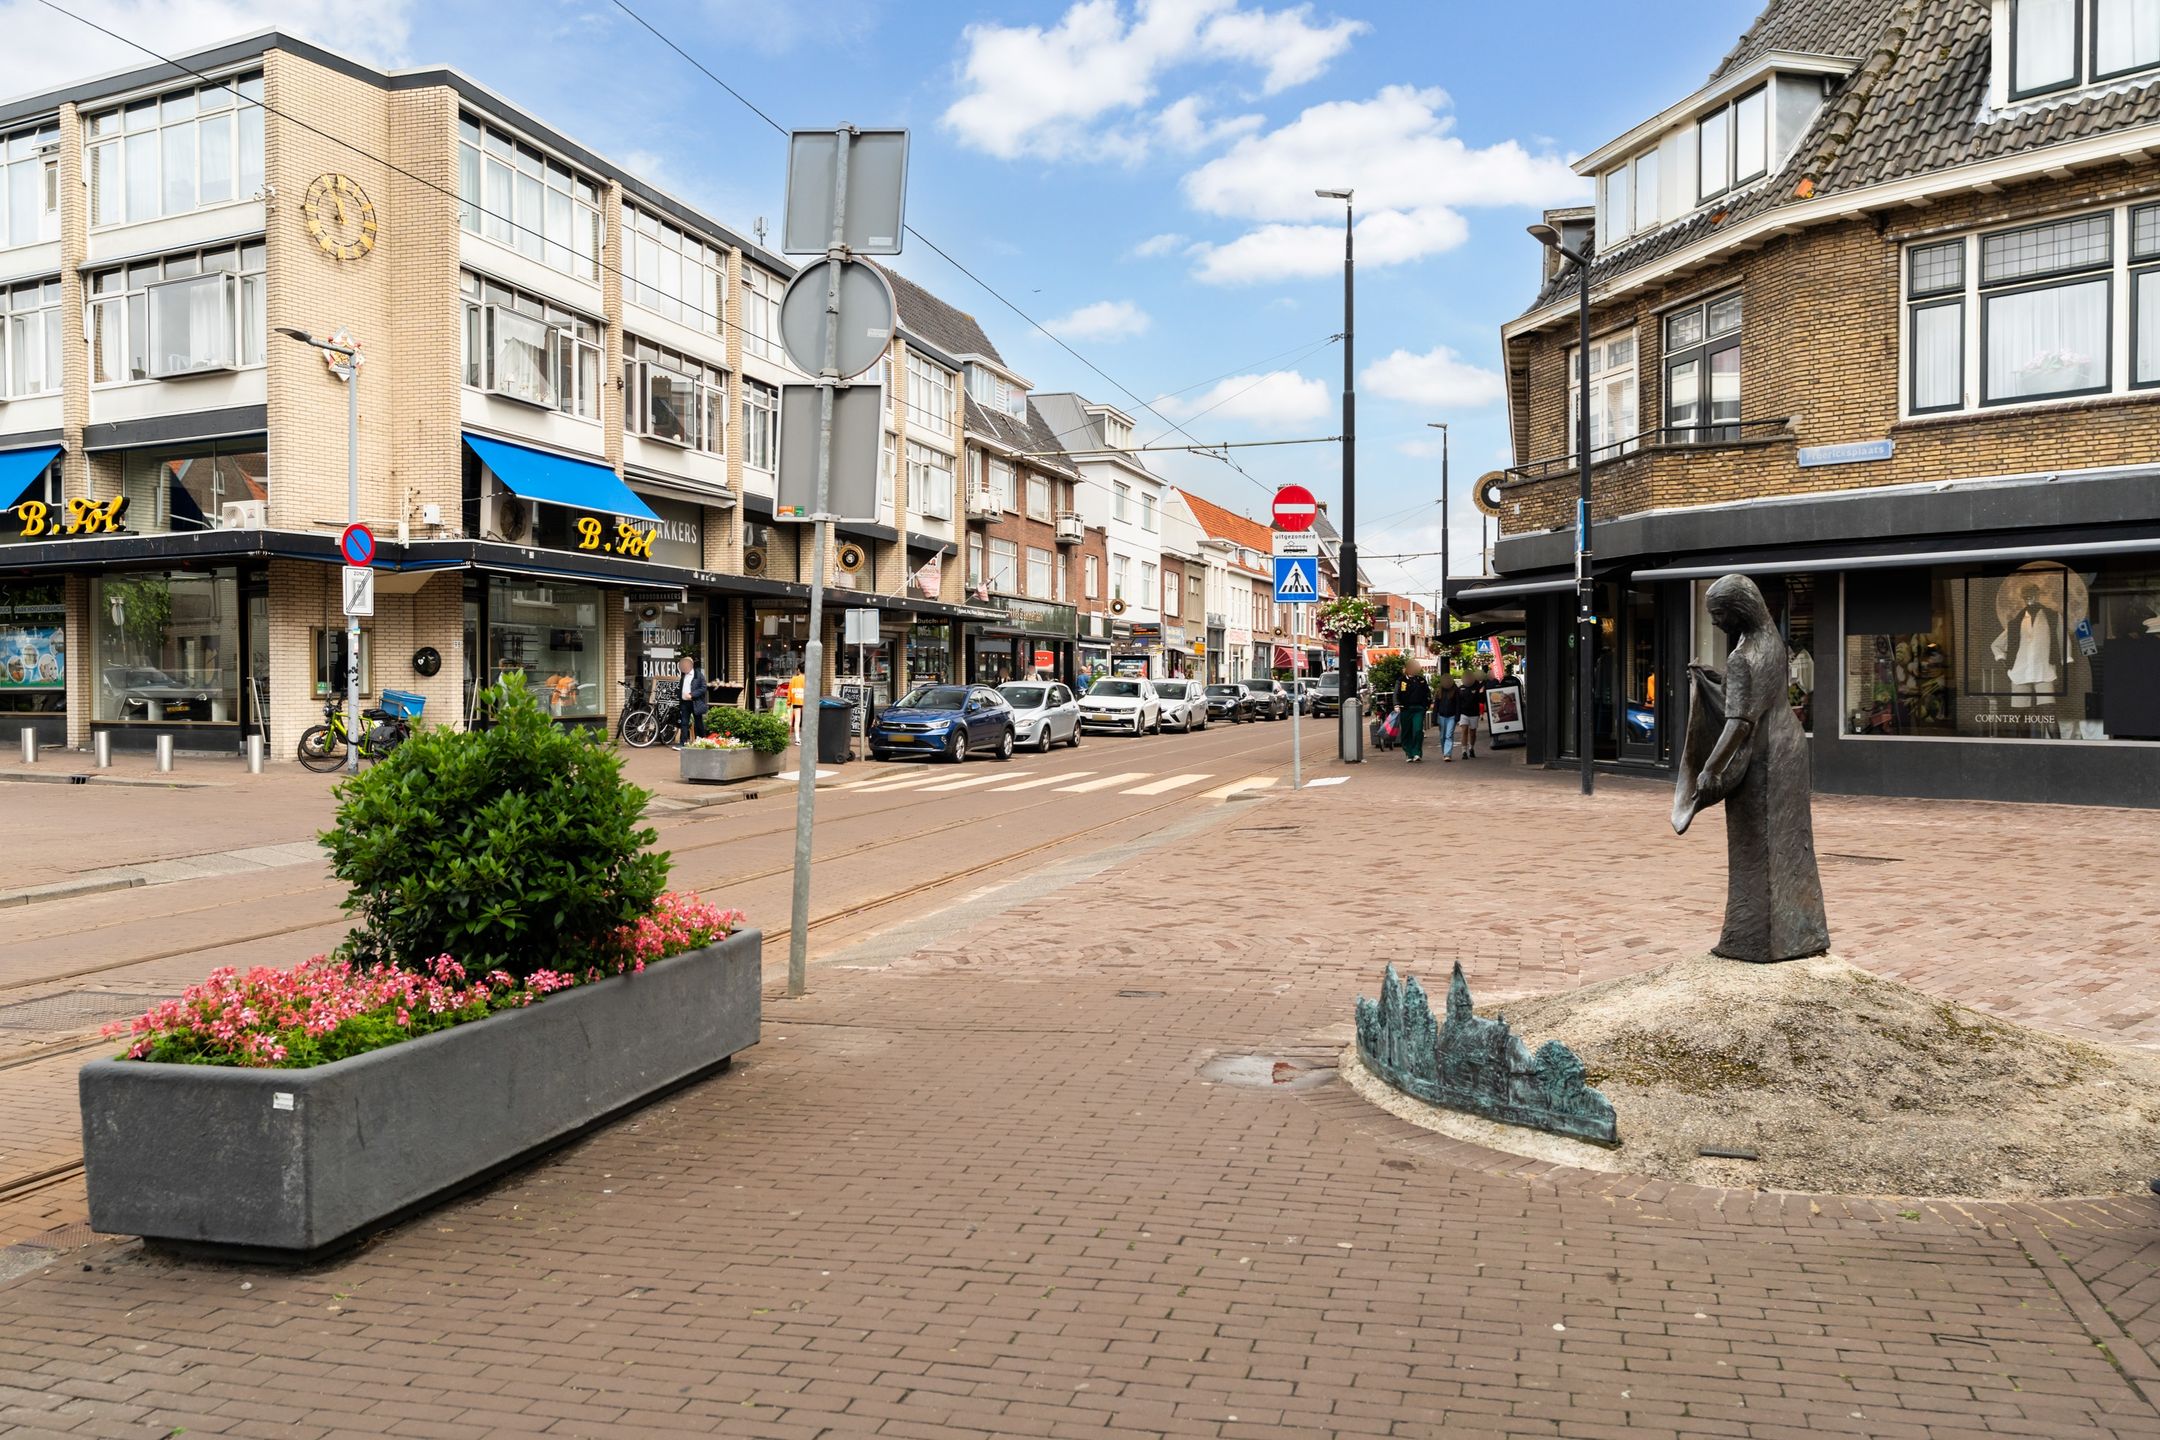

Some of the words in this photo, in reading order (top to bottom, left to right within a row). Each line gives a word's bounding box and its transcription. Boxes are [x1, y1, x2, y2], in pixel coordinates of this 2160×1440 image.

[18, 500, 60, 536] B.
[578, 517, 611, 552] B.
[643, 627, 653, 643] DE
[655, 628, 681, 645] BROOD
[643, 660, 681, 678] BAKKERS
[1975, 714, 2021, 723] COUNTRY
[2024, 715, 2055, 724] HOUSE
